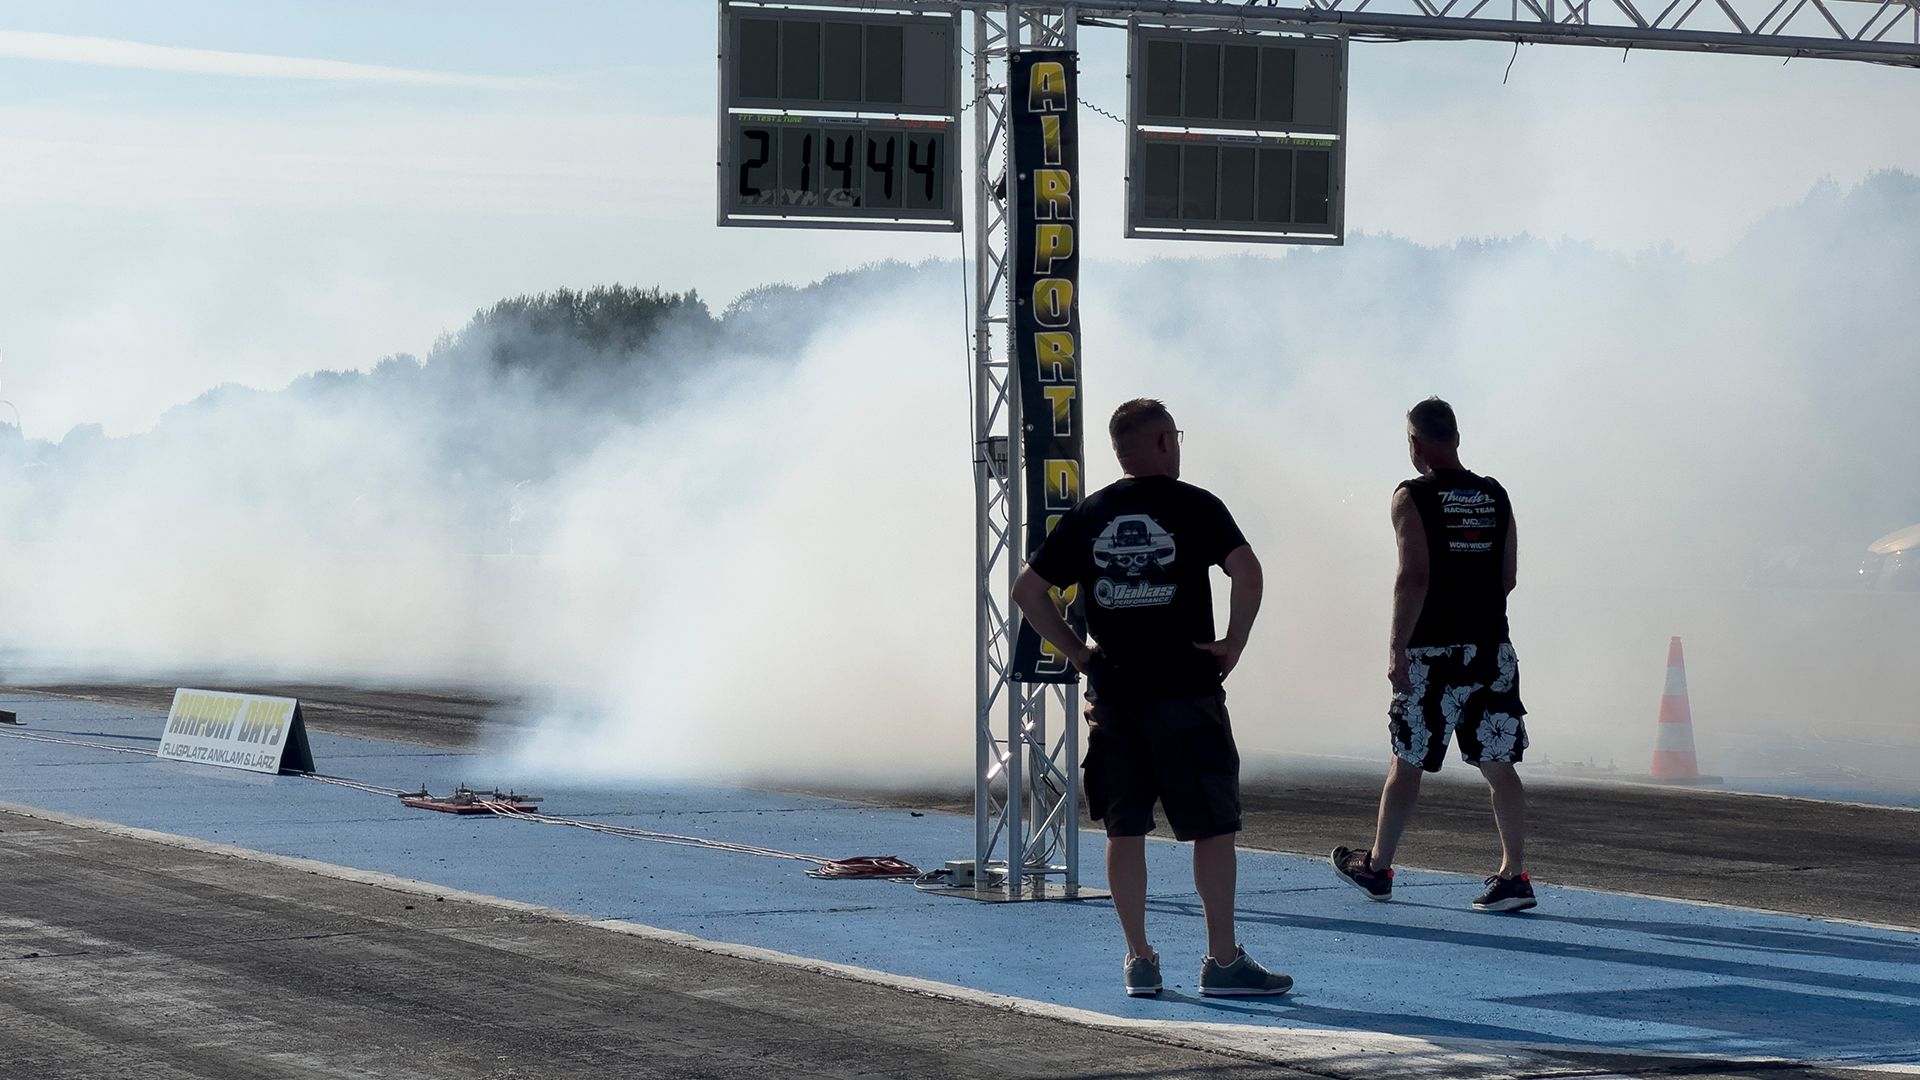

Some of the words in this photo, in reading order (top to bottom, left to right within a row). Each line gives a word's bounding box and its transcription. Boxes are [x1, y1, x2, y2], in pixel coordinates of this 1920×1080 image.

[1028, 62, 1077, 436] AIRPORT
[1438, 490, 1496, 504] Thunder
[1034, 459, 1080, 674] DYS
[1114, 582, 1175, 600] Dallas
[1114, 597, 1171, 606] PERFORMANCE
[168, 693, 243, 740] AIRPORT
[237, 700, 290, 746] DAYS
[162, 742, 208, 760] FLUGPLATZ
[207, 749, 245, 766] ANKLAM
[244, 754, 251, 766] &
[251, 750, 276, 769] LÄRZ
